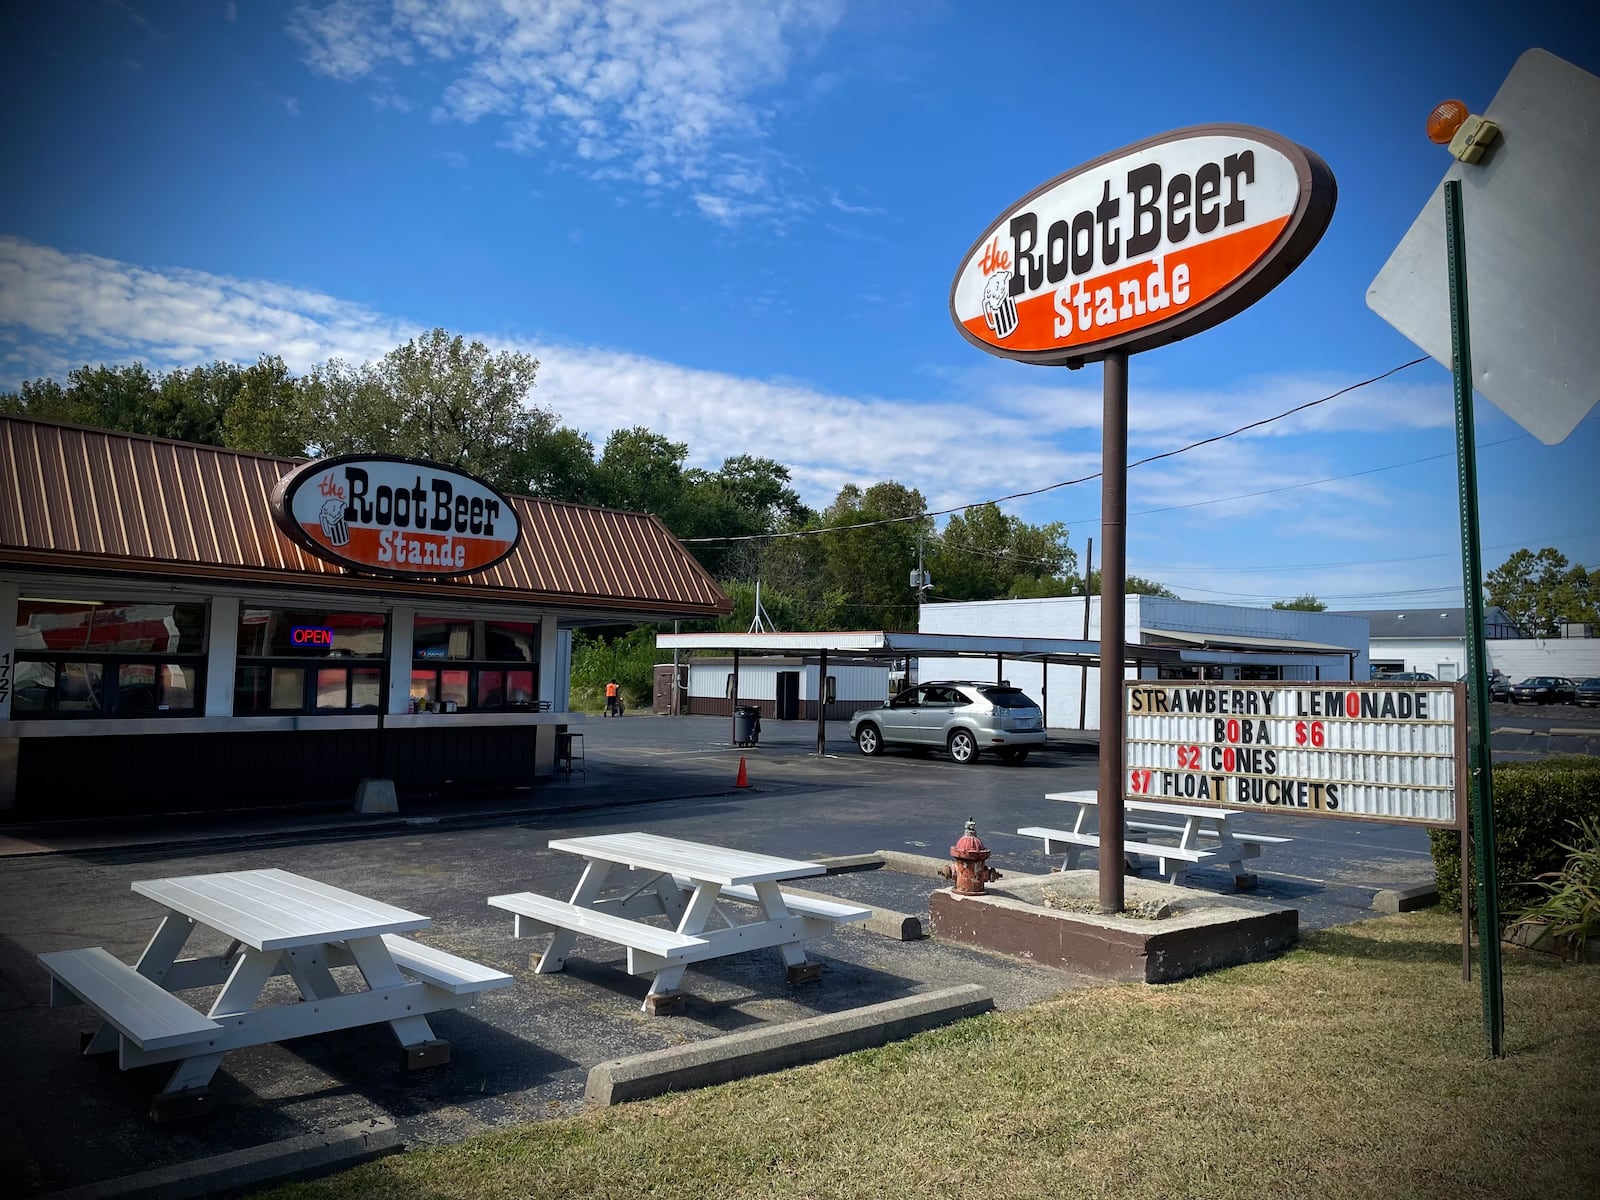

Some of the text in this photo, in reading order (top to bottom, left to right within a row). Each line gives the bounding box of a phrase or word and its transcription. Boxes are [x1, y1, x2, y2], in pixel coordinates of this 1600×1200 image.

[979, 237, 1011, 275] the
[1053, 256, 1191, 340] Stande
[317, 472, 346, 500] the
[377, 530, 466, 568] Stande
[294, 629, 332, 644] OPEN
[1131, 688, 1429, 720] STRAWBERRY LEMONADE
[1213, 718, 1325, 748] BOBA $6
[1177, 745, 1277, 776] $2 CONES
[1131, 770, 1338, 810] $7 FLOAT BUCKETS
